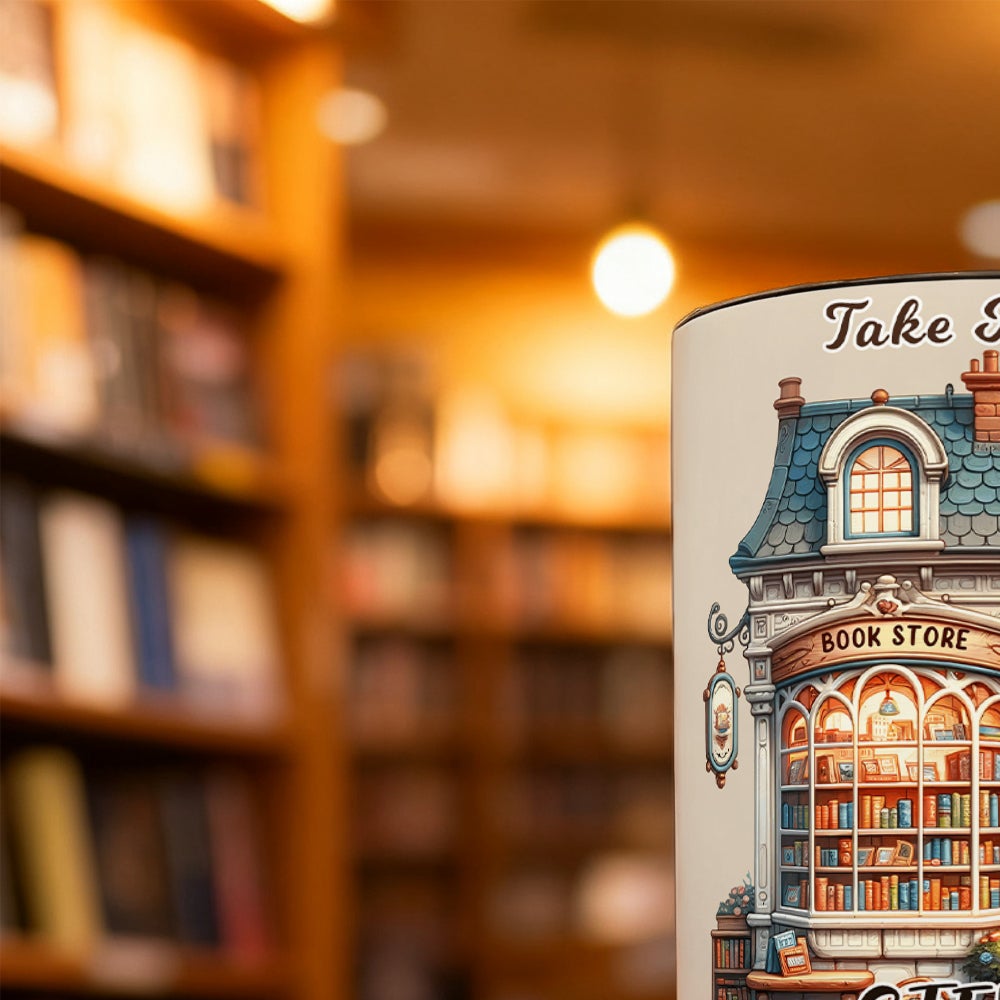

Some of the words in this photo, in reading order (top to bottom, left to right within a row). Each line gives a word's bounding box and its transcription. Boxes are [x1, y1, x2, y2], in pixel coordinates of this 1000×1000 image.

[826, 299, 953, 350] Take
[821, 626, 882, 654] BOOK
[892, 624, 970, 651] STORE
